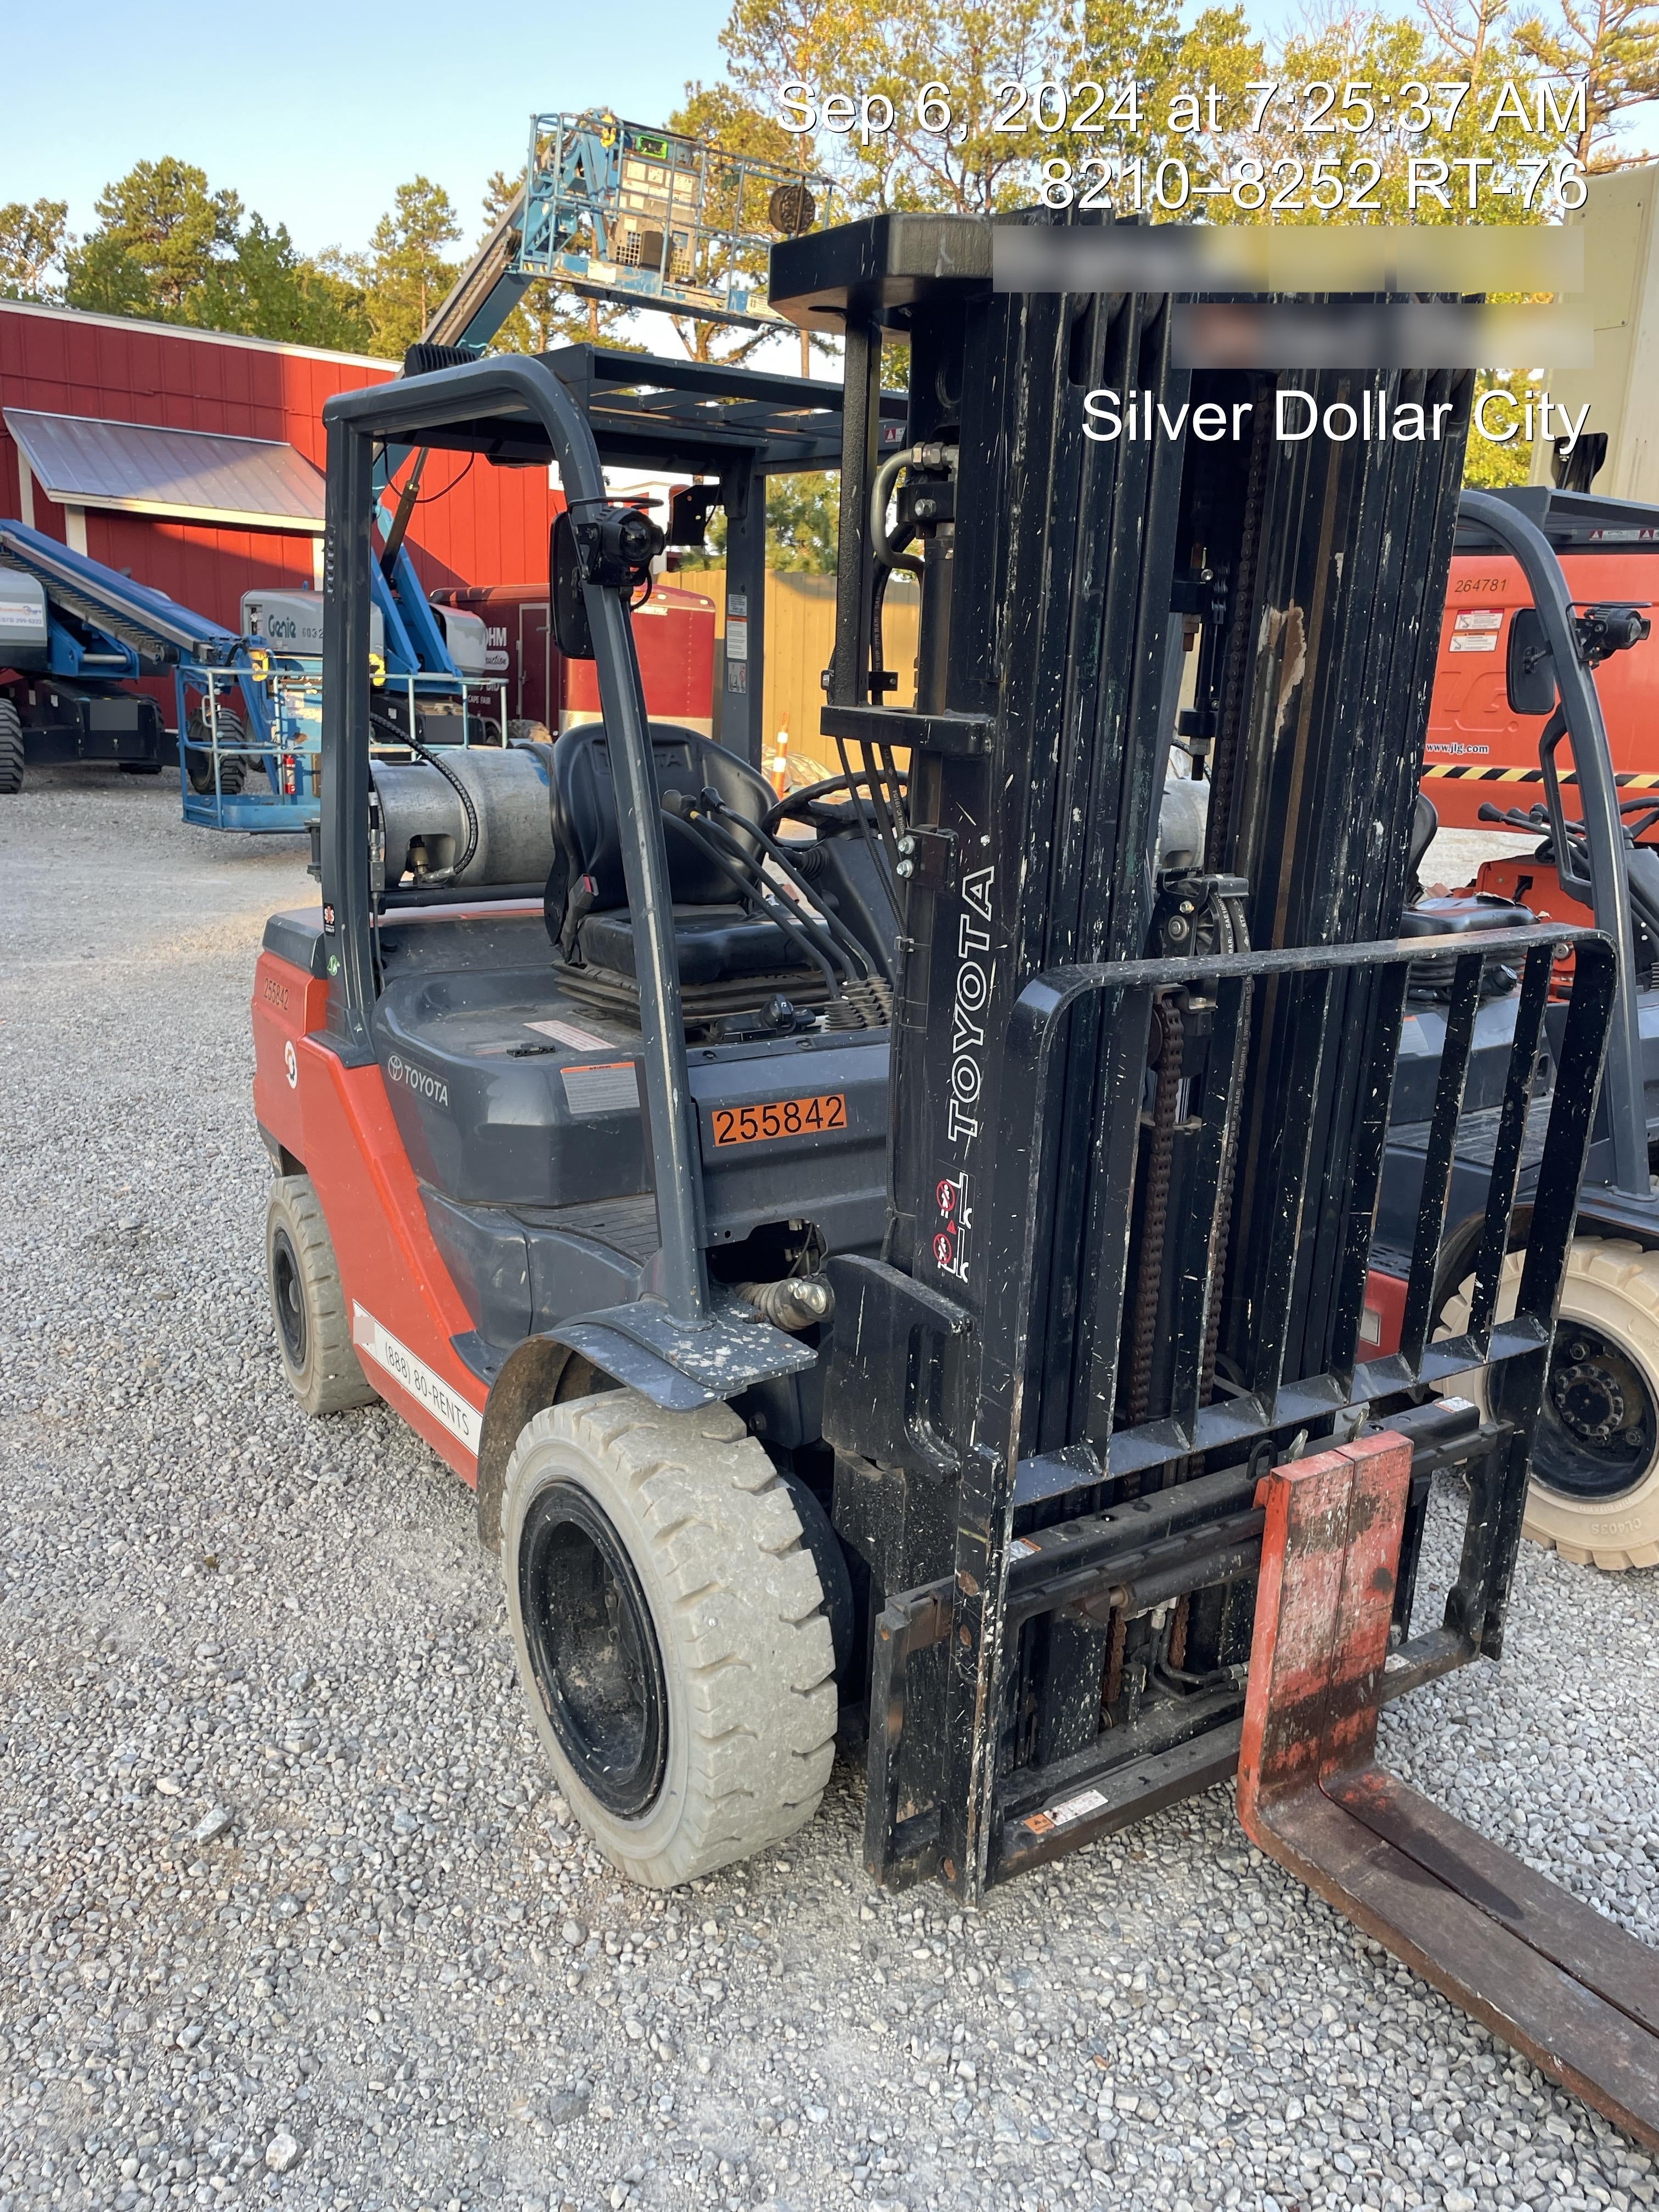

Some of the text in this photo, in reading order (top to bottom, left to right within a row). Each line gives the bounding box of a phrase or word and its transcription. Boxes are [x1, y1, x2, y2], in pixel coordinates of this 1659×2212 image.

[1454, 579, 1507, 592] 264781
[268, 614, 296, 638] Genie
[1426, 742, 1488, 754] www.jlg.com
[1238, 914, 1246, 928] 6TX
[264, 978, 289, 1011] 255842
[947, 866, 995, 1142] TOYOTA
[404, 1064, 448, 1106] TOYOTA
[716, 1096, 844, 1144] 255842
[385, 1341, 469, 1436] (888) 80-RENTS
[1591, 1517, 1641, 1535] CL403S
